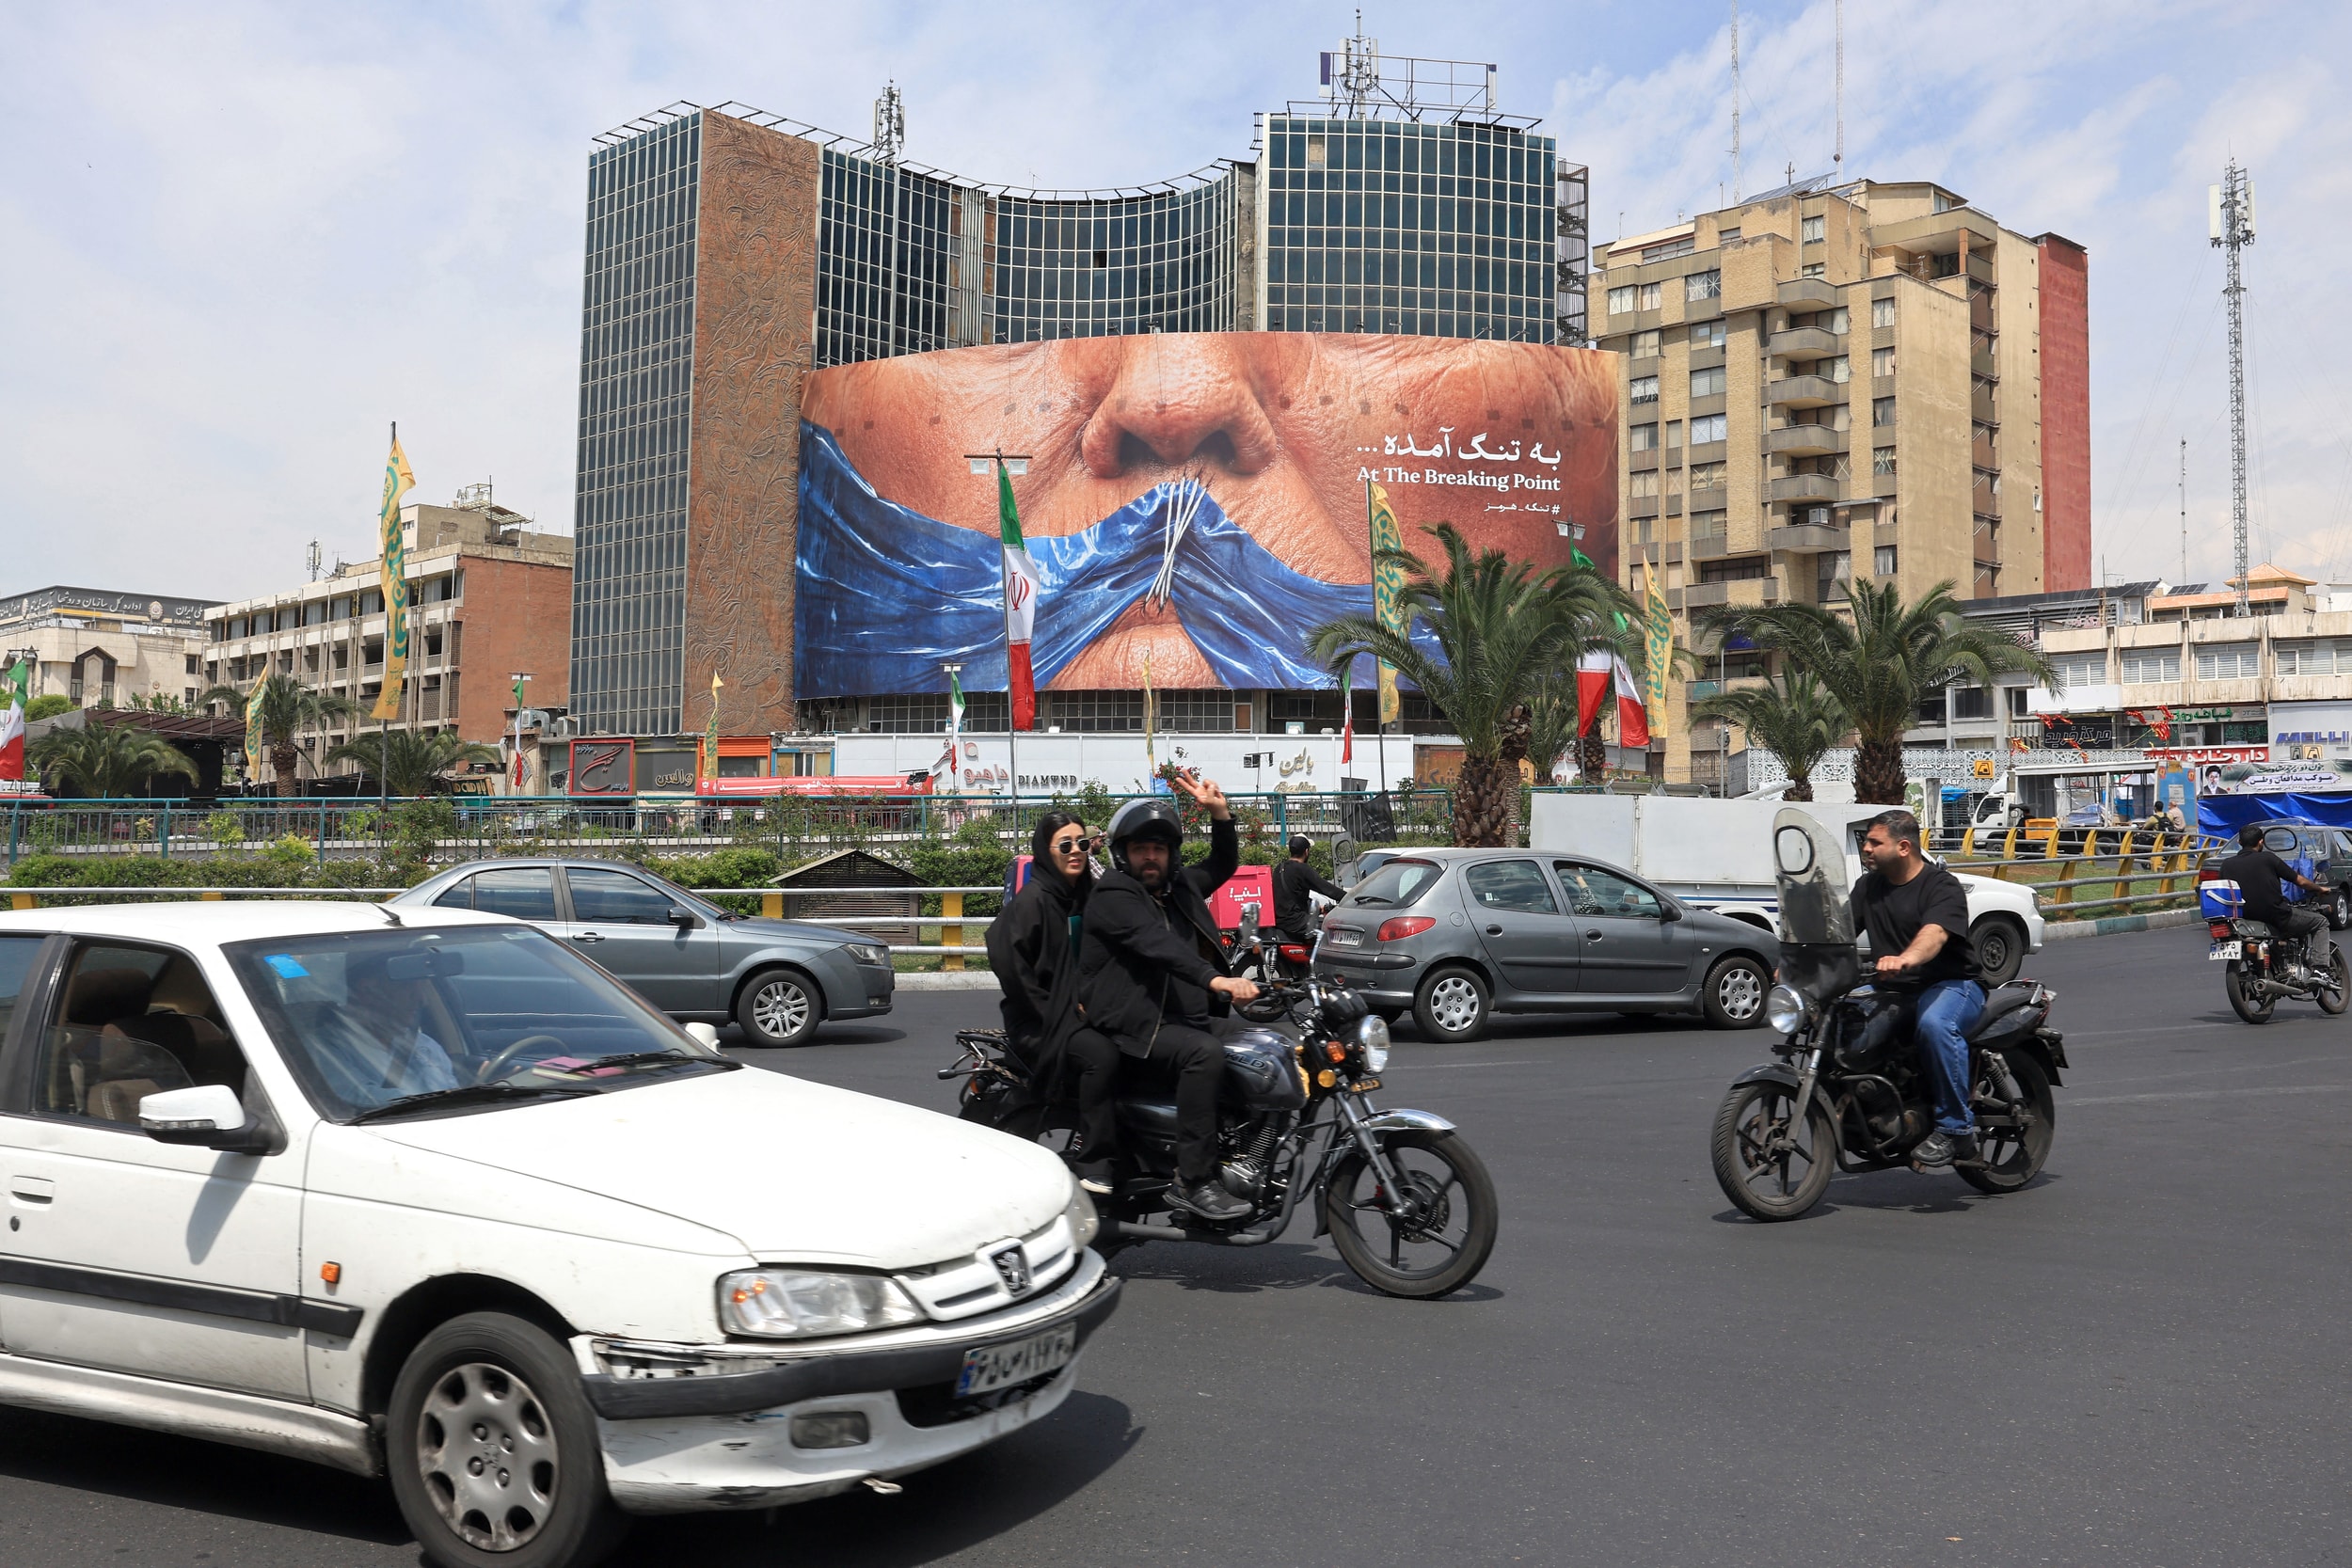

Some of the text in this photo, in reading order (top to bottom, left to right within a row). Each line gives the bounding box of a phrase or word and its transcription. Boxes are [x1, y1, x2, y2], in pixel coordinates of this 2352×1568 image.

[1458, 433, 1520, 461] تنگ
[1530, 442, 1562, 471] به
[1357, 467, 1561, 492] At The Breaking Point
[122, 602, 142, 611] اداره
[175, 605, 194, 619] ایران
[174, 618, 192, 626] BANK
[2045, 725, 2111, 748] مرکز خرید
[2276, 731, 2349, 744] MELLI
[1279, 746, 1313, 776] بالین
[2185, 749, 2265, 764] داروخانه
[1902, 761, 1960, 771] میدان حضرت
[655, 768, 694, 787] والس
[2249, 774, 2333, 785] موکب مدافعان وطن
